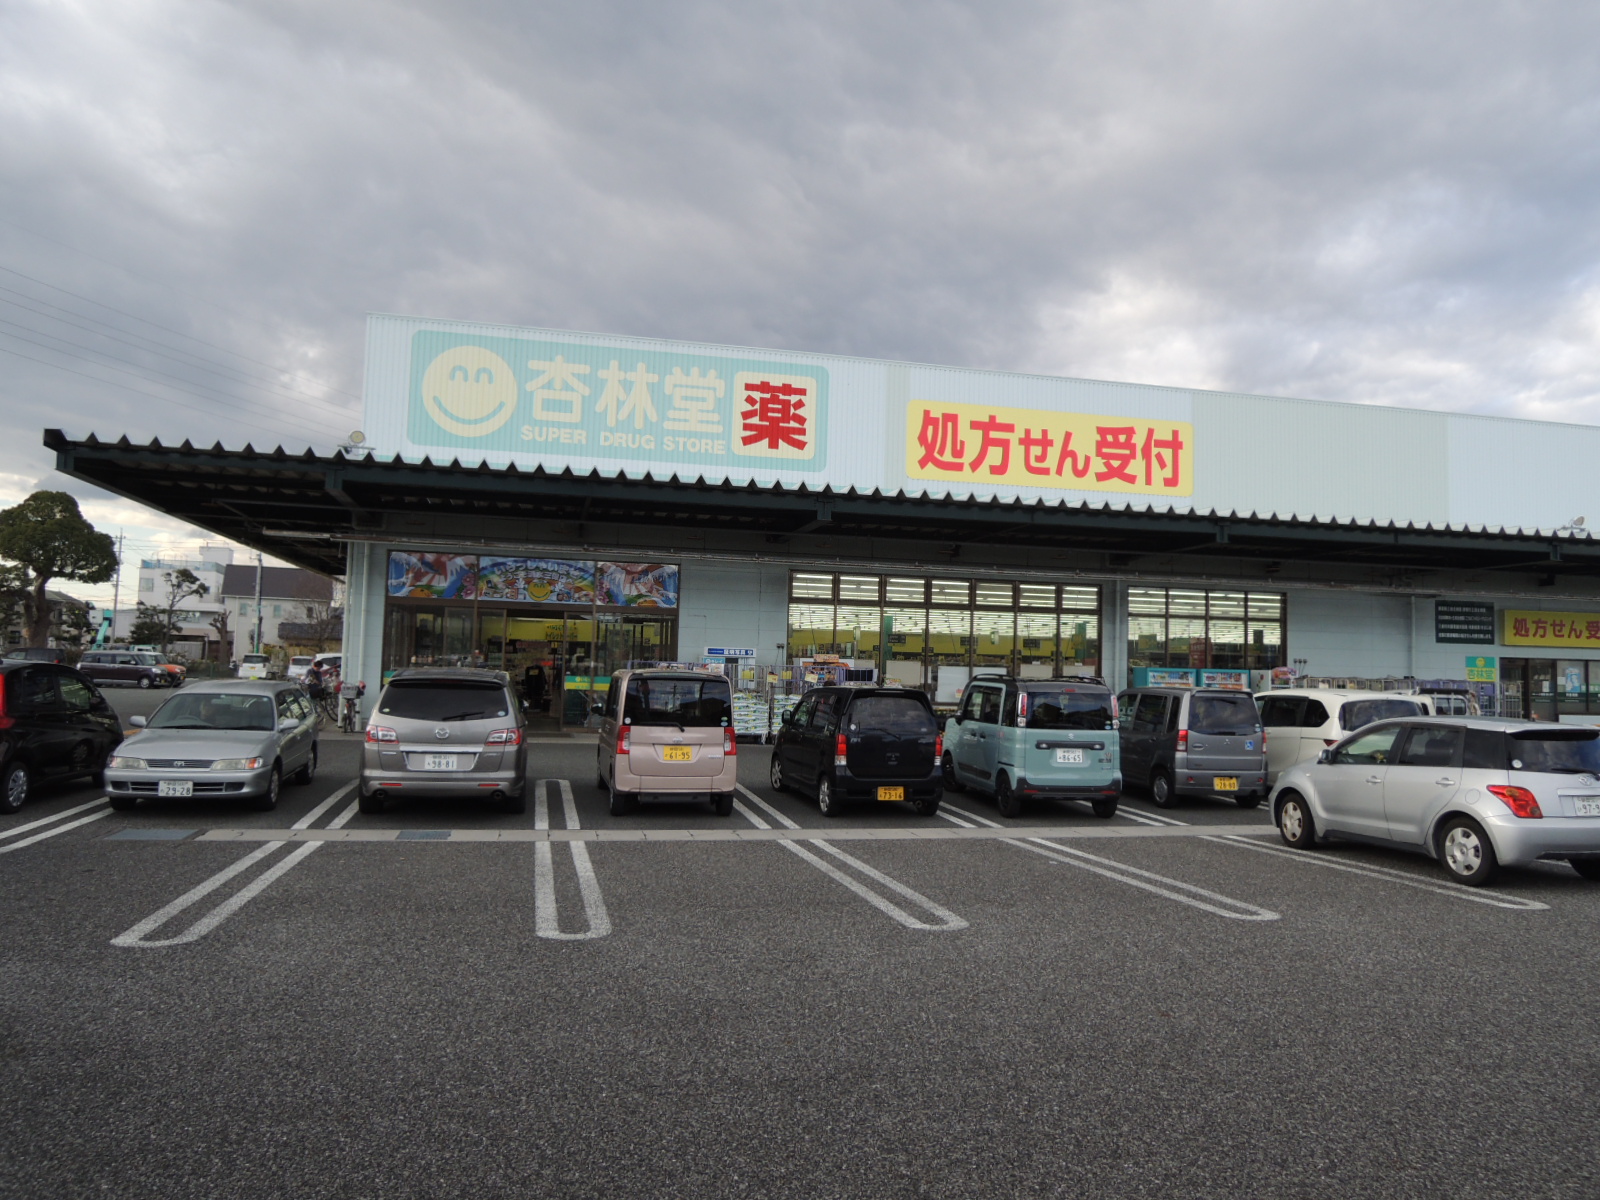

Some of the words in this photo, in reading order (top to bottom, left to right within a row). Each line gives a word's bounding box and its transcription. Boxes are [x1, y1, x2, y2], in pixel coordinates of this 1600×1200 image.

[525, 354, 727, 434] 杏林堂
[740, 380, 808, 451] 薬
[520, 424, 588, 446] SUPER
[599, 430, 656, 451] DRUG
[662, 435, 727, 455] STORE
[917, 408, 1184, 488] 処方せん受付
[494, 560, 581, 579] いらっしゃいませ
[1467, 668, 1494, 680] 杏林堂
[669, 751, 691, 760] 61-95
[431, 759, 455, 769] 98-81
[165, 786, 191, 796] 29-28
[882, 791, 903, 800] 73-16
